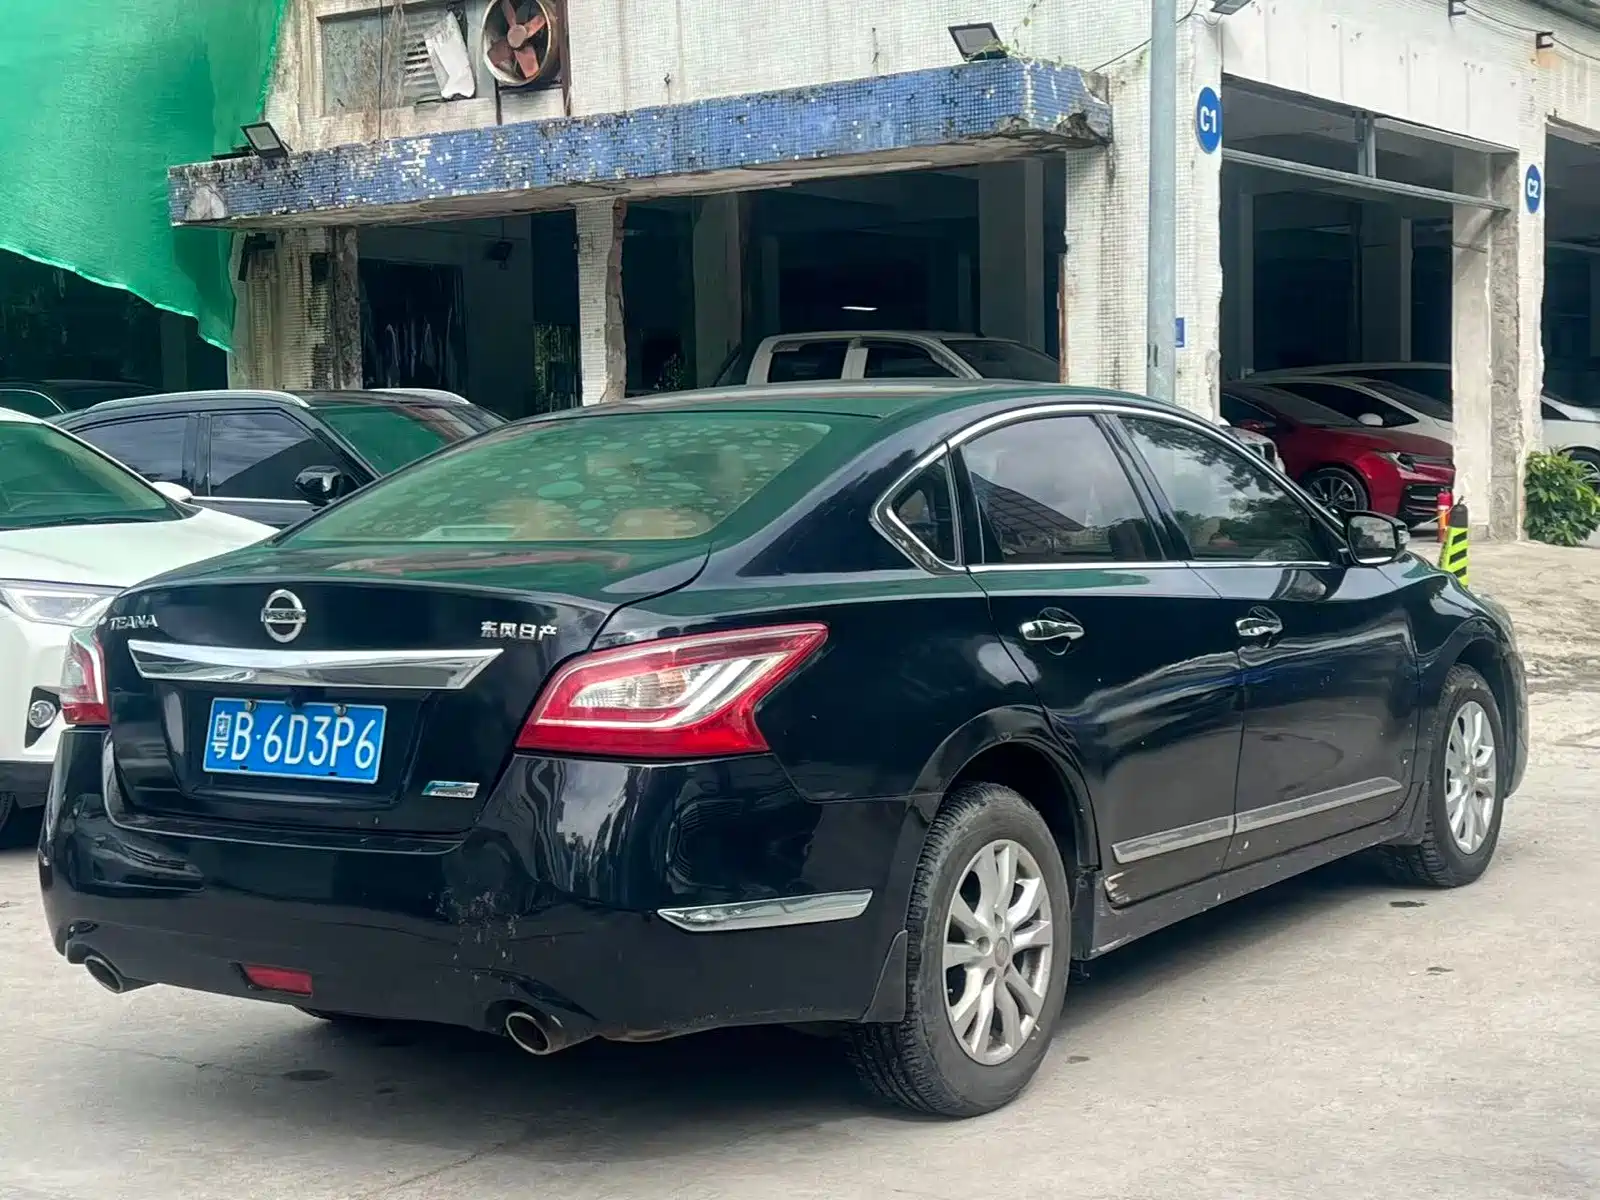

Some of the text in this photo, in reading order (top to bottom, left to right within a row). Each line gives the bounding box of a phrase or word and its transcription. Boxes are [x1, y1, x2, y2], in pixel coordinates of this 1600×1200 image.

[1201, 105, 1217, 133] C1
[1527, 177, 1539, 199] C2
[110, 614, 159, 630] TEANA
[480, 621, 558, 641] 东风日产
